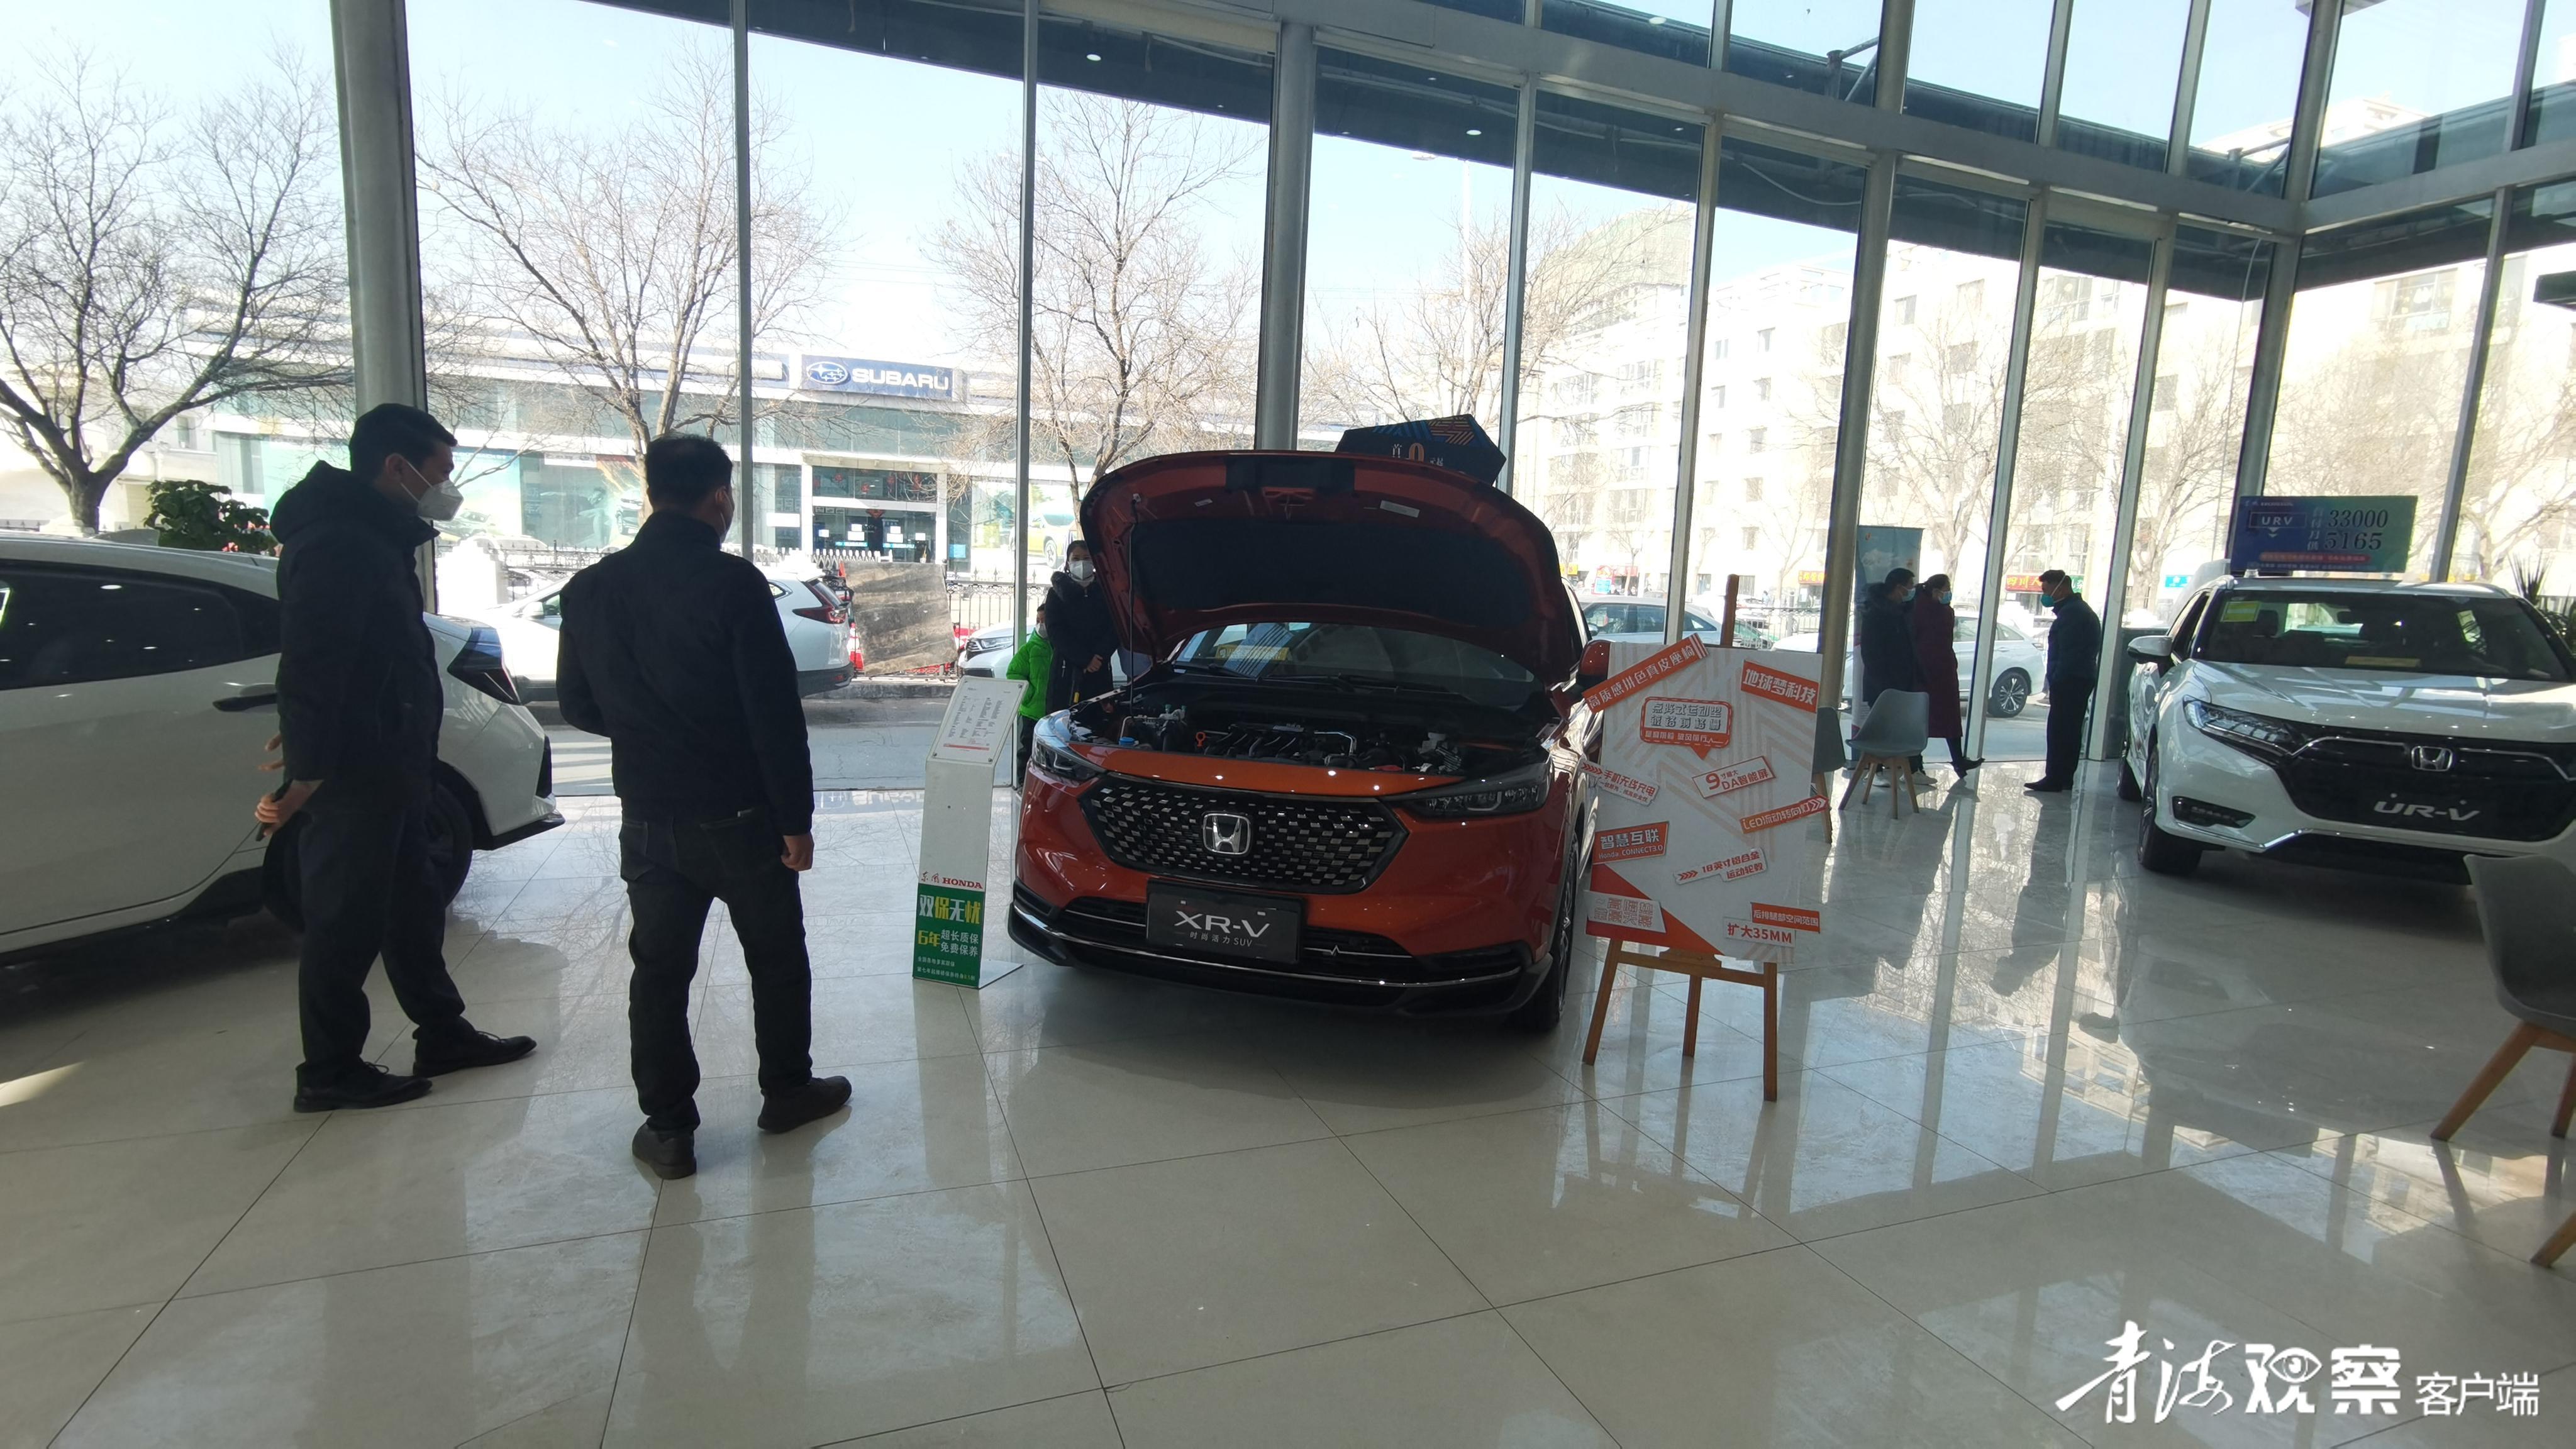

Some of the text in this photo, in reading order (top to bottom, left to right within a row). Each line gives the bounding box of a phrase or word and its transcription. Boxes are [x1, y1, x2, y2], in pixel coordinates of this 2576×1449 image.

[852, 367, 949, 391] SUBARU
[2262, 516, 2294, 525] URV
[2328, 509, 2389, 528] 33000
[2324, 532, 2382, 551] 5165
[1743, 669, 1816, 705] 地球梦科技
[1604, 770, 1656, 797] 手机无线充电
[1705, 772, 1721, 790] 9
[1721, 769, 1769, 791] DA智能屏
[1742, 803, 1811, 830] LED流动转向灯
[2373, 801, 2480, 821] UR-V
[1600, 828, 1660, 850] 智慧互联
[1599, 851, 1619, 860] Honda
[1702, 851, 1760, 873] 18英寸铝合金
[1726, 862, 1763, 879] 运动轮毂
[942, 877, 984, 889] HONDA
[919, 894, 981, 924] 双保无忧
[1753, 909, 1819, 927] 后排腿部空间范围
[1174, 911, 1270, 938] XR-V
[1727, 922, 1792, 944] 扩大35MM
[918, 929, 979, 947] 6年 超长质保
[1190, 931, 1253, 947] 时尚活力 SUV
[940, 942, 979, 957] 免费保养
